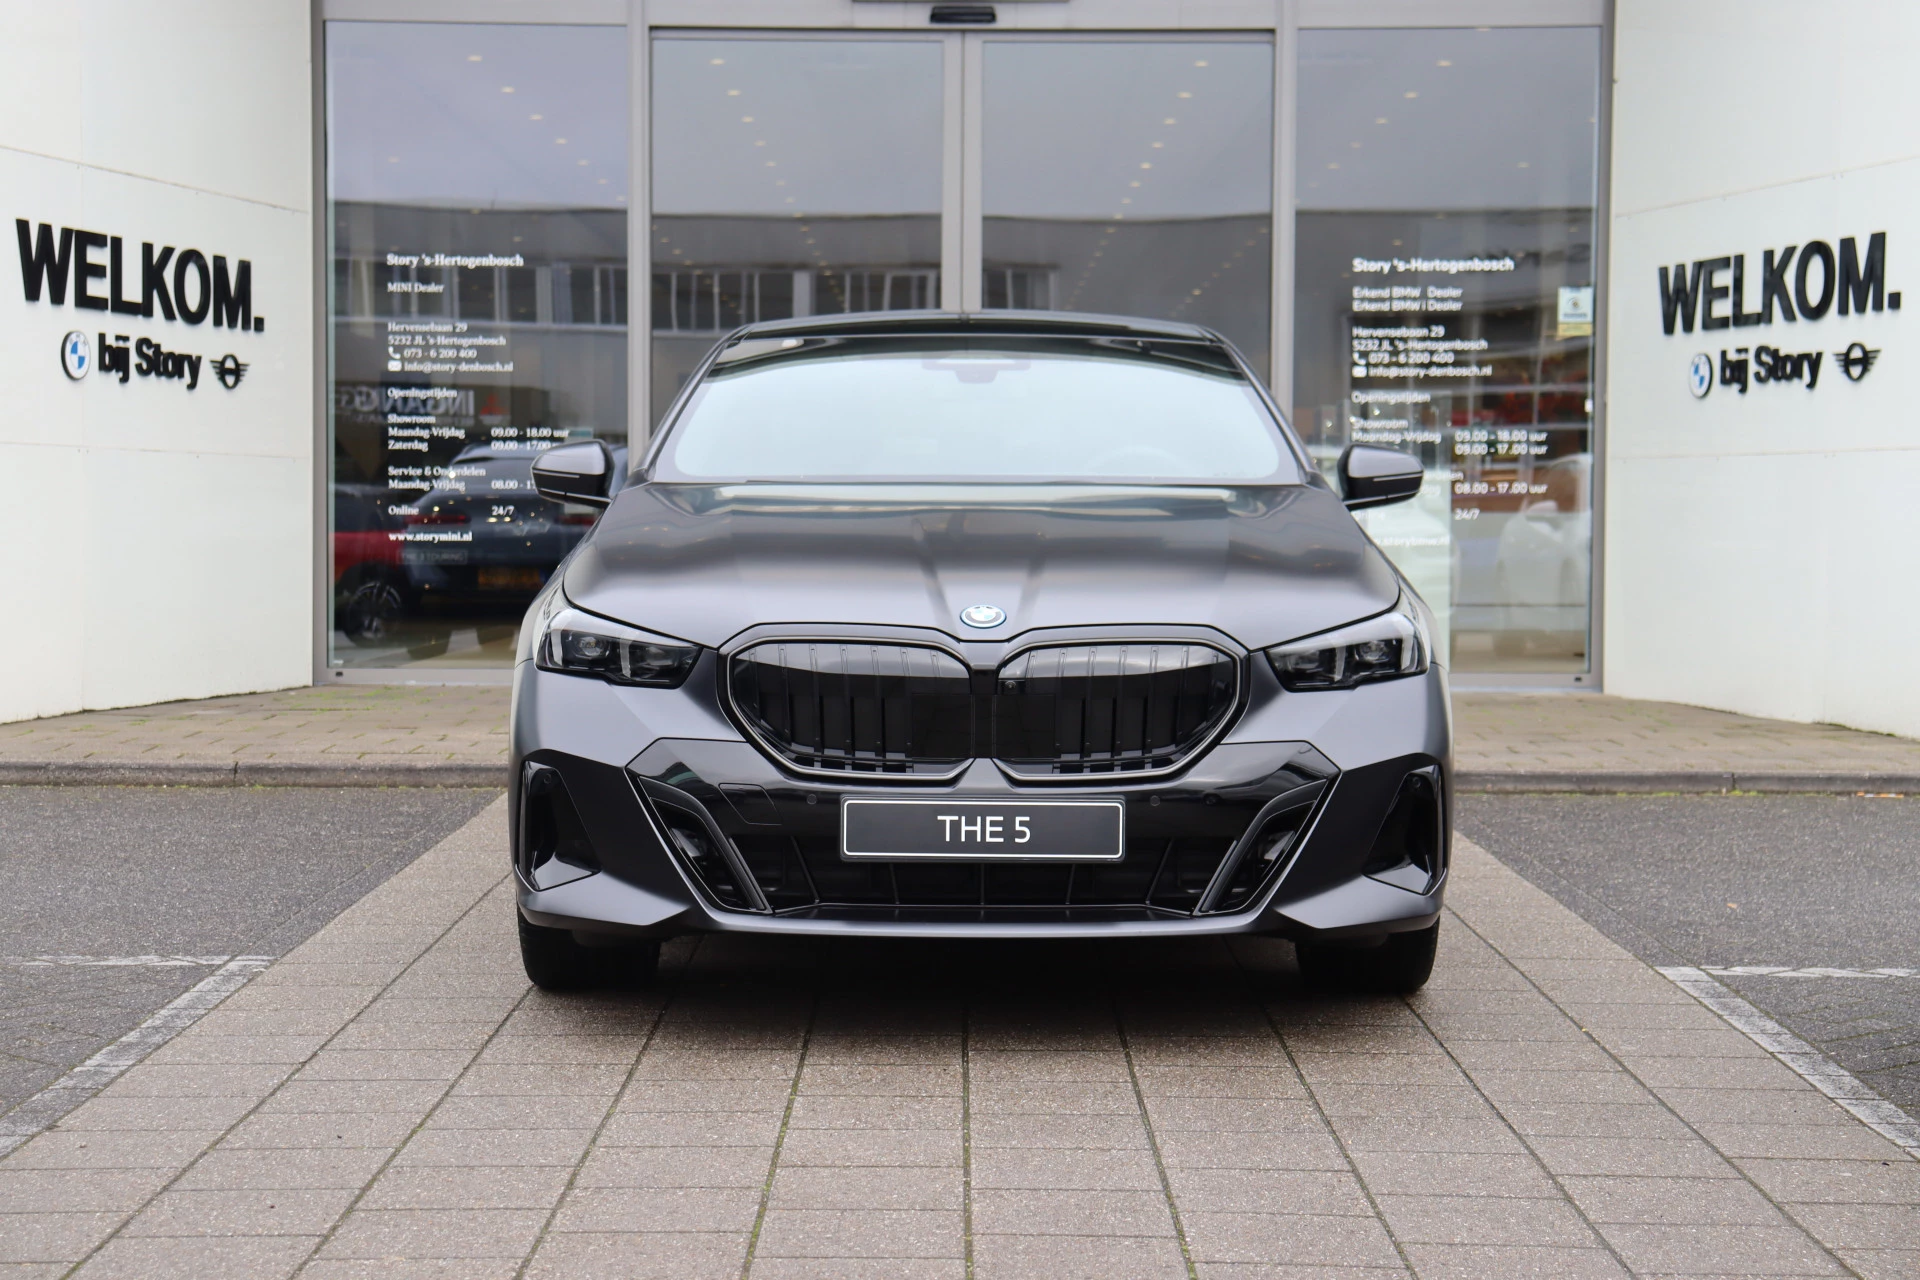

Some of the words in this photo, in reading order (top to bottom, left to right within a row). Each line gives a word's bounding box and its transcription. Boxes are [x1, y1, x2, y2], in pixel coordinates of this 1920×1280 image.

[387, 254, 418, 268] Story
[1352, 258, 1390, 274] Story
[16, 218, 264, 332] WELKOM.
[414, 282, 444, 293] Dealer
[1658, 231, 1902, 335] WELKOM.
[1352, 287, 1390, 298] Erkend
[1392, 287, 1421, 298] BMW
[1427, 287, 1463, 298] Dealer
[1352, 300, 1390, 311] Erkend
[1392, 300, 1419, 311] BMW
[1427, 300, 1463, 311] Dealer
[455, 322, 467, 332] 29
[1430, 326, 1445, 337] 29
[404, 348, 423, 358] 073
[430, 348, 437, 358] 6
[439, 348, 457, 358] 200
[459, 348, 477, 358] 400
[1369, 352, 1389, 363] 073
[1408, 352, 1430, 363] 200
[1432, 352, 1454, 363] 400
[98, 333, 130, 383] bij
[135, 337, 202, 390] Story
[1720, 348, 1749, 395] bij
[1754, 346, 1823, 389] Story
[388, 414, 436, 424] Showroom
[526, 428, 551, 437] 18.00
[388, 440, 428, 452] Zaterdag
[388, 466, 422, 476] Service
[388, 505, 419, 515] Online
[491, 505, 514, 515] 24/7
[1455, 509, 1480, 520] 24/7
[388, 532, 472, 544] www.storymini.nl
[937, 816, 1004, 842] THE
[1014, 816, 1031, 843] 5
